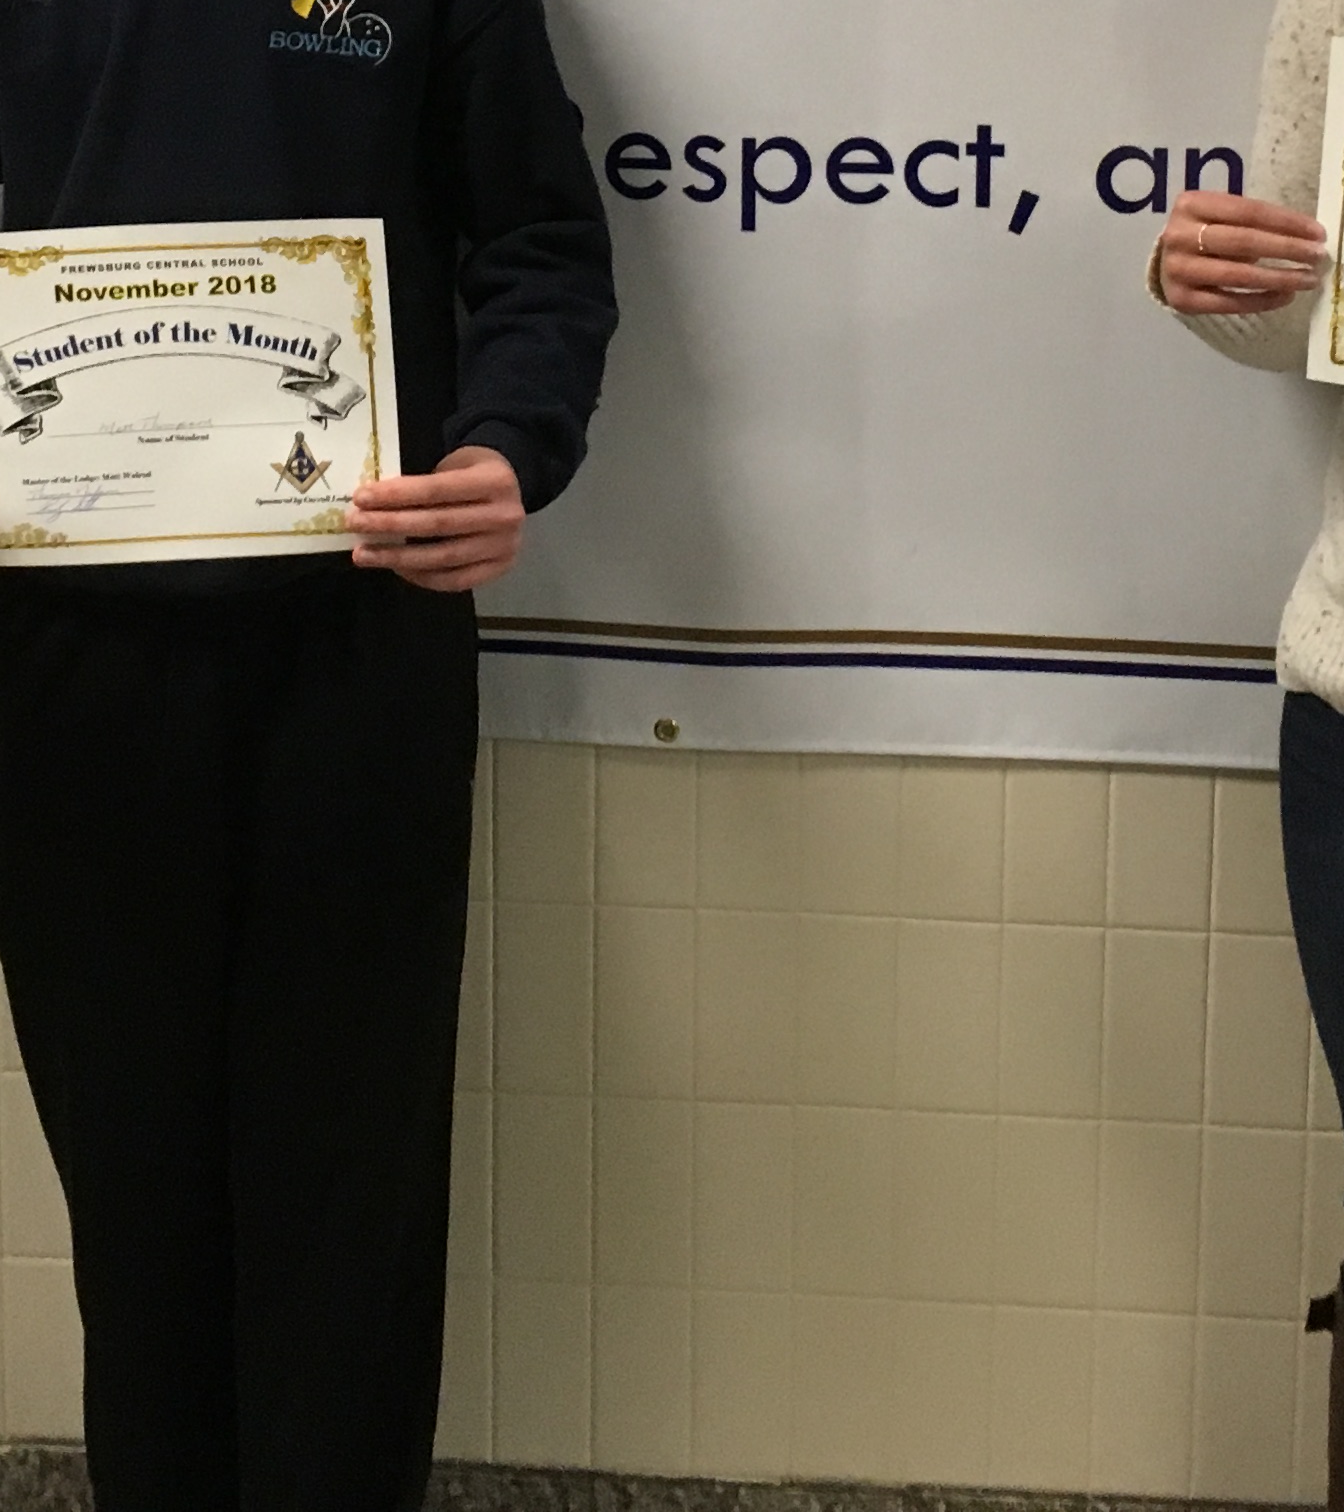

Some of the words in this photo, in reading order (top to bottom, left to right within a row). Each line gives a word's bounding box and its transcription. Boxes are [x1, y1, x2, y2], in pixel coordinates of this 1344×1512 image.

[269, 30, 382, 57] BOWLING
[60, 261, 141, 274] FREWSBURG
[146, 259, 206, 270] CENTRAL
[211, 257, 264, 267] SCHOOL
[54, 279, 199, 303] November
[207, 274, 277, 295] 2018
[13, 326, 125, 372] Student
[134, 321, 166, 345] of
[170, 321, 217, 345] the
[226, 322, 318, 361] Month
